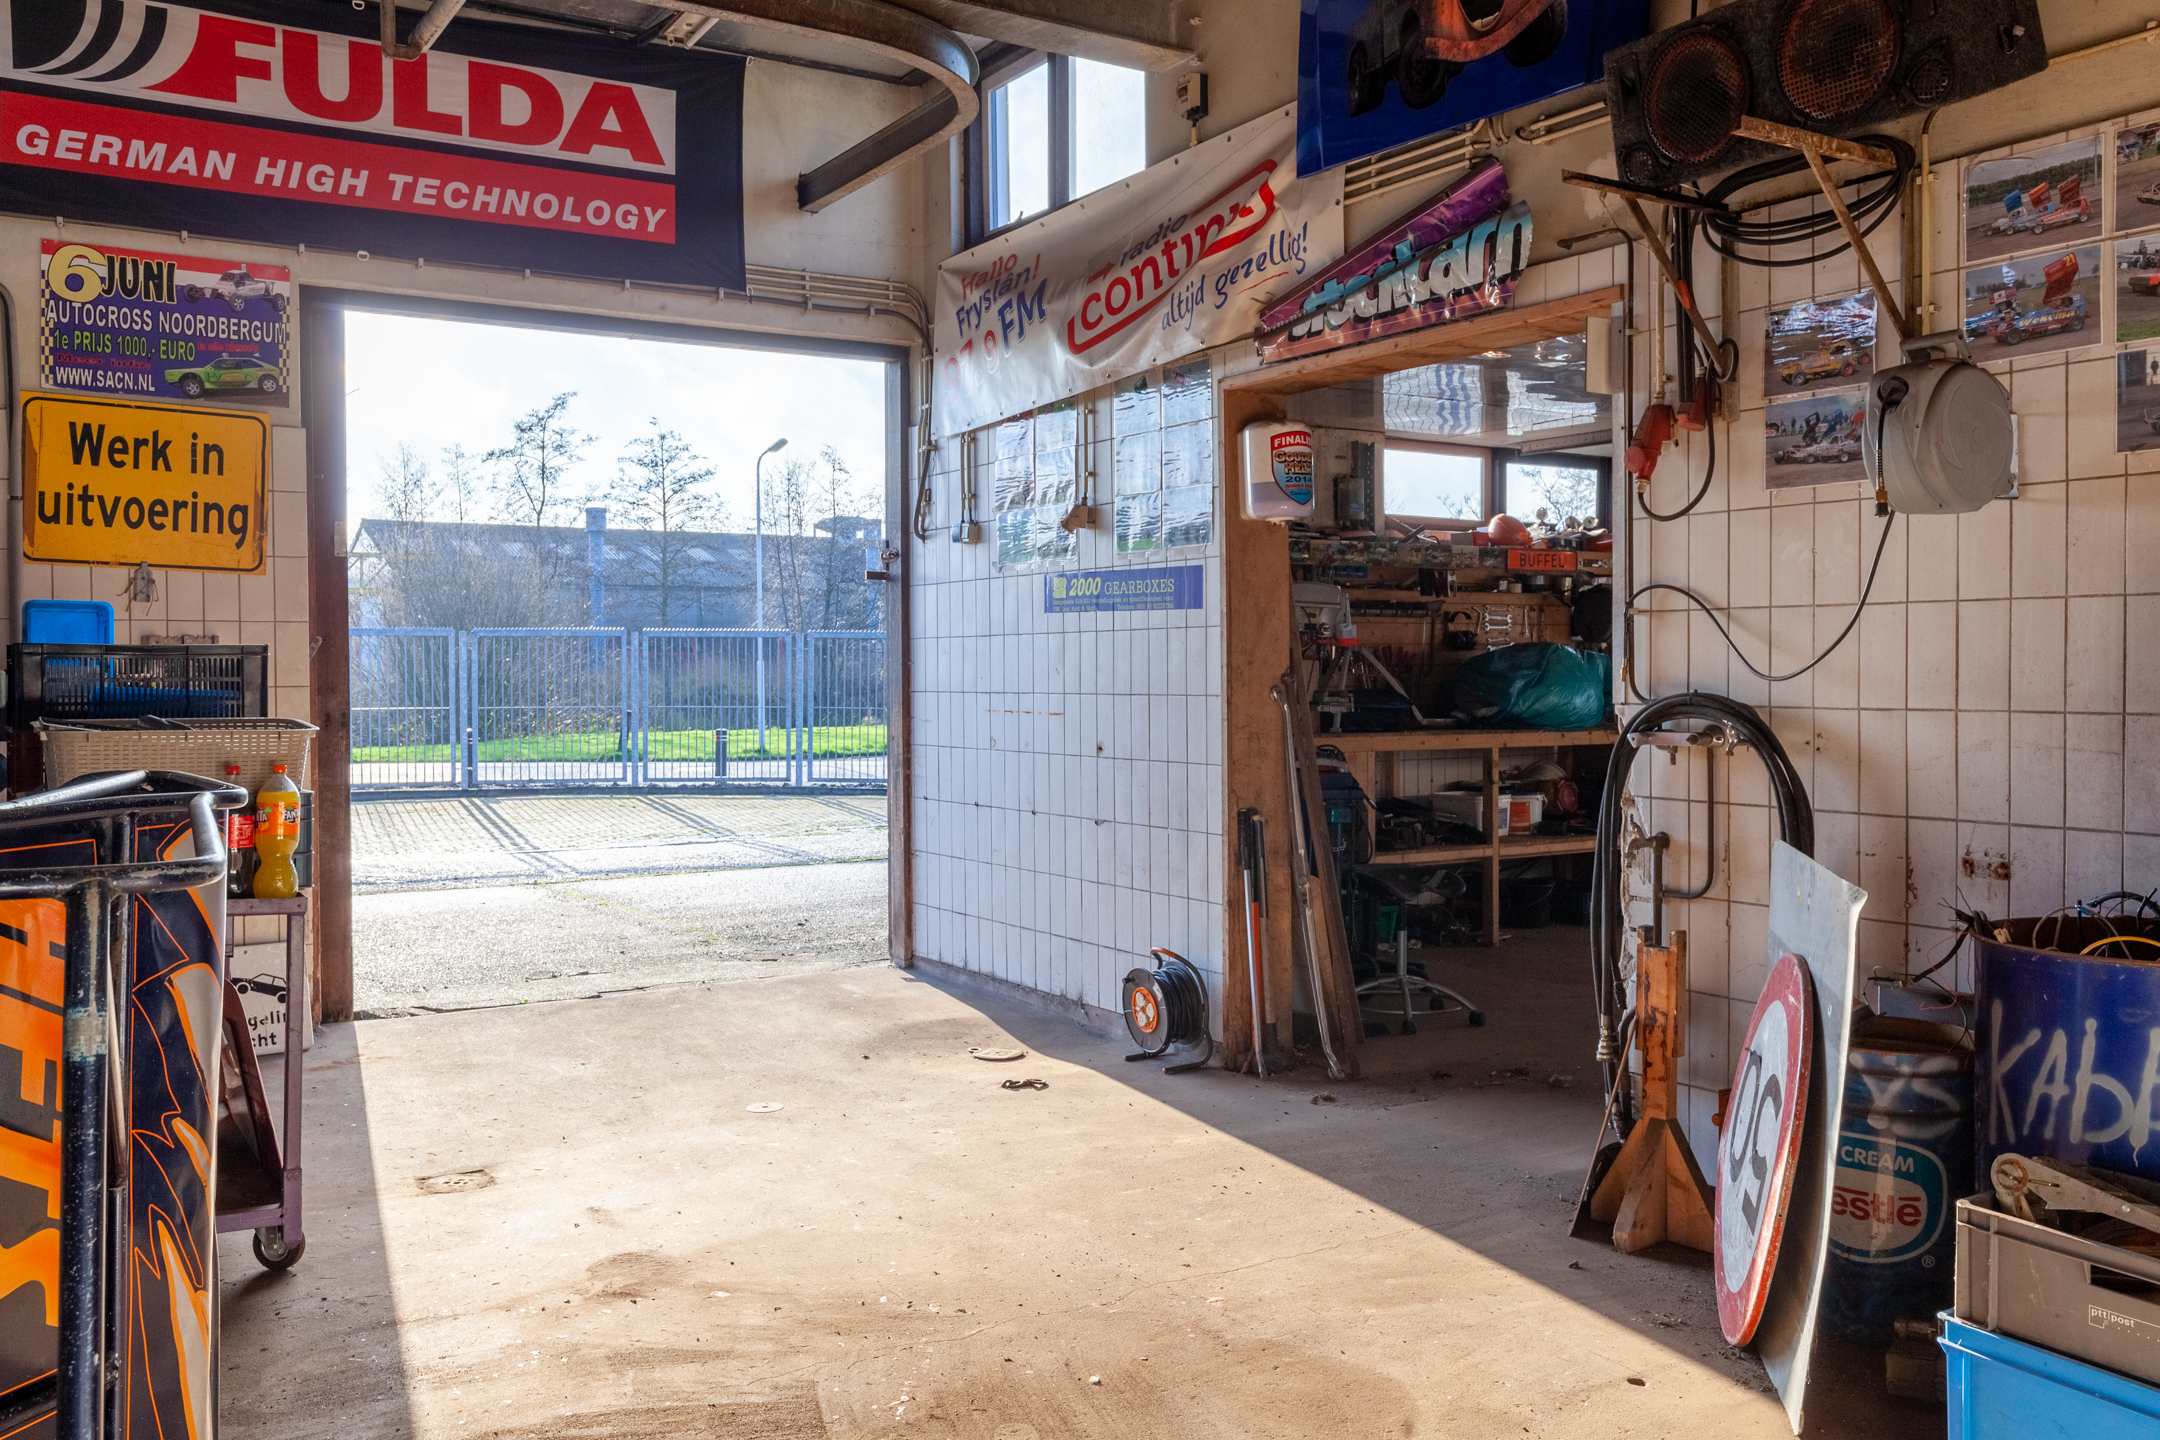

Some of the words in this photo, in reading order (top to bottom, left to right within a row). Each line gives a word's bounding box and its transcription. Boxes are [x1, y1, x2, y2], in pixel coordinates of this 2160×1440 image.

[141, 14, 667, 167] FULDA
[16, 124, 237, 181] GERMAN
[254, 157, 367, 198] HIGH
[387, 174, 667, 234] TECHNOLOGY
[1119, 213, 1189, 268] radio
[47, 244, 109, 303] 6
[101, 253, 178, 305] JUNI
[961, 253, 1019, 301] Hallo
[1160, 274, 1207, 333] altijd
[1213, 220, 1309, 310] gezellig!
[46, 299, 153, 332] AUTOCROSS
[158, 311, 287, 345] NOORDBERGUM
[997, 277, 1048, 358] FM
[53, 329, 69, 350] 1e
[73, 330, 112, 353] PRIJS
[159, 339, 196, 362] EURO
[57, 353, 105, 366] Meer
[55, 366, 156, 392] WWW.SACN.NL
[69, 421, 173, 473] Werk
[190, 432, 224, 476] in
[38, 482, 249, 550] uitvoering
[1519, 552, 1566, 569] BUFFEL
[1069, 577, 1102, 596] 2000
[1104, 578, 1175, 595] GEARBOXES
[1840, 1145, 1915, 1174] CREAM
[1831, 1187, 1922, 1228] estlé
[2091, 1308, 2108, 1319] ptt
[2110, 1314, 2135, 1328] post
